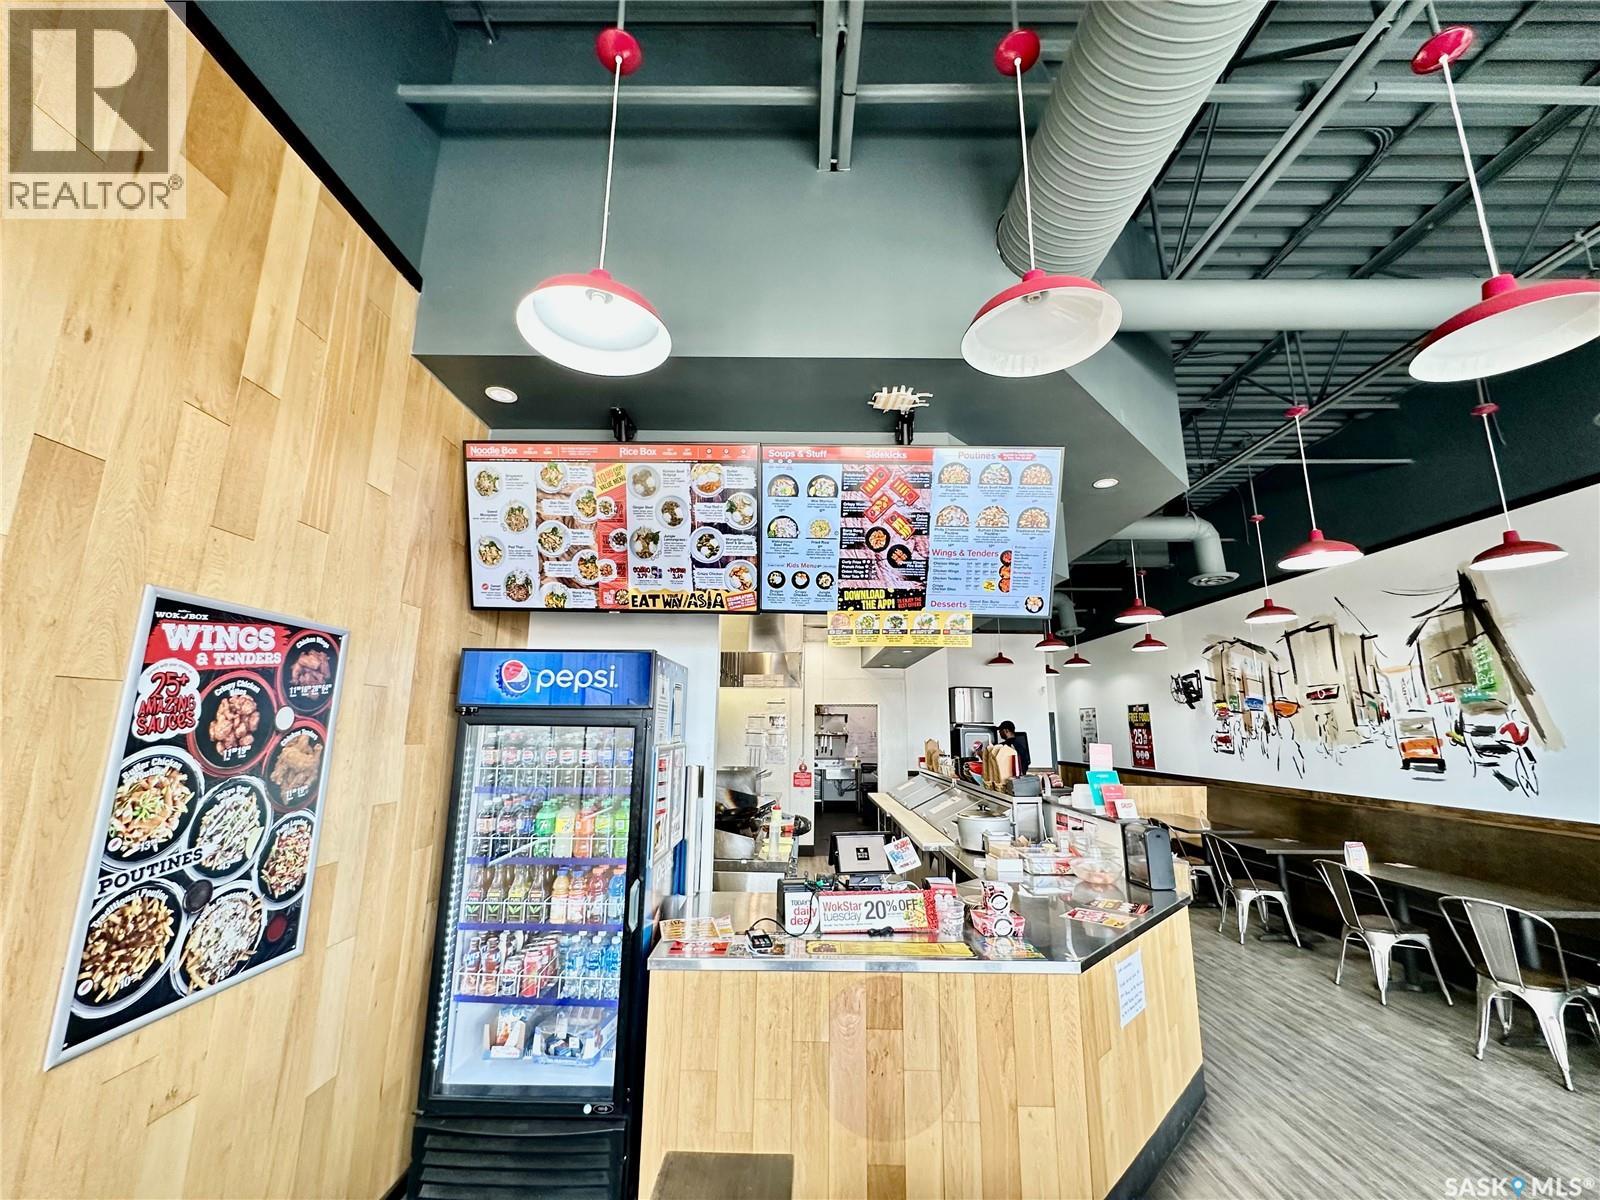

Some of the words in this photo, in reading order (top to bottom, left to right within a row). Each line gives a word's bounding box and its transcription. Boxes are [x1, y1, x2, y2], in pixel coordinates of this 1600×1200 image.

[470, 446, 500, 456] Noodle
[501, 446, 519, 455] Box
[620, 447, 638, 456] Rice
[640, 447, 657, 456] Box
[768, 450, 796, 458] Soups
[797, 450, 805, 458] &
[806, 450, 827, 458] Stuff
[865, 450, 907, 459] Sidekicks
[958, 452, 996, 460] Poutines
[931, 549, 957, 557] Wings
[843, 589, 886, 600] DOWNLOAD
[631, 594, 660, 608] EAT
[861, 600, 877, 610] THE
[930, 600, 968, 608] Desserts
[155, 611, 180, 619] WOK
[161, 622, 276, 651] WINGS
[196, 653, 208, 665] &
[213, 652, 282, 666] TENDERS
[535, 664, 617, 693] pepsi
[150, 671, 190, 700] 25+
[214, 682, 236, 696] Crispy
[236, 680, 260, 694] Chicken
[137, 694, 197, 717] AMAZING
[121, 761, 150, 780] Butter
[150, 757, 183, 770] Chicken
[99, 849, 204, 894] POUTINES
[822, 901, 862, 912] WokStar
[900, 898, 918, 911] OFF
[823, 911, 862, 922] tuesday
